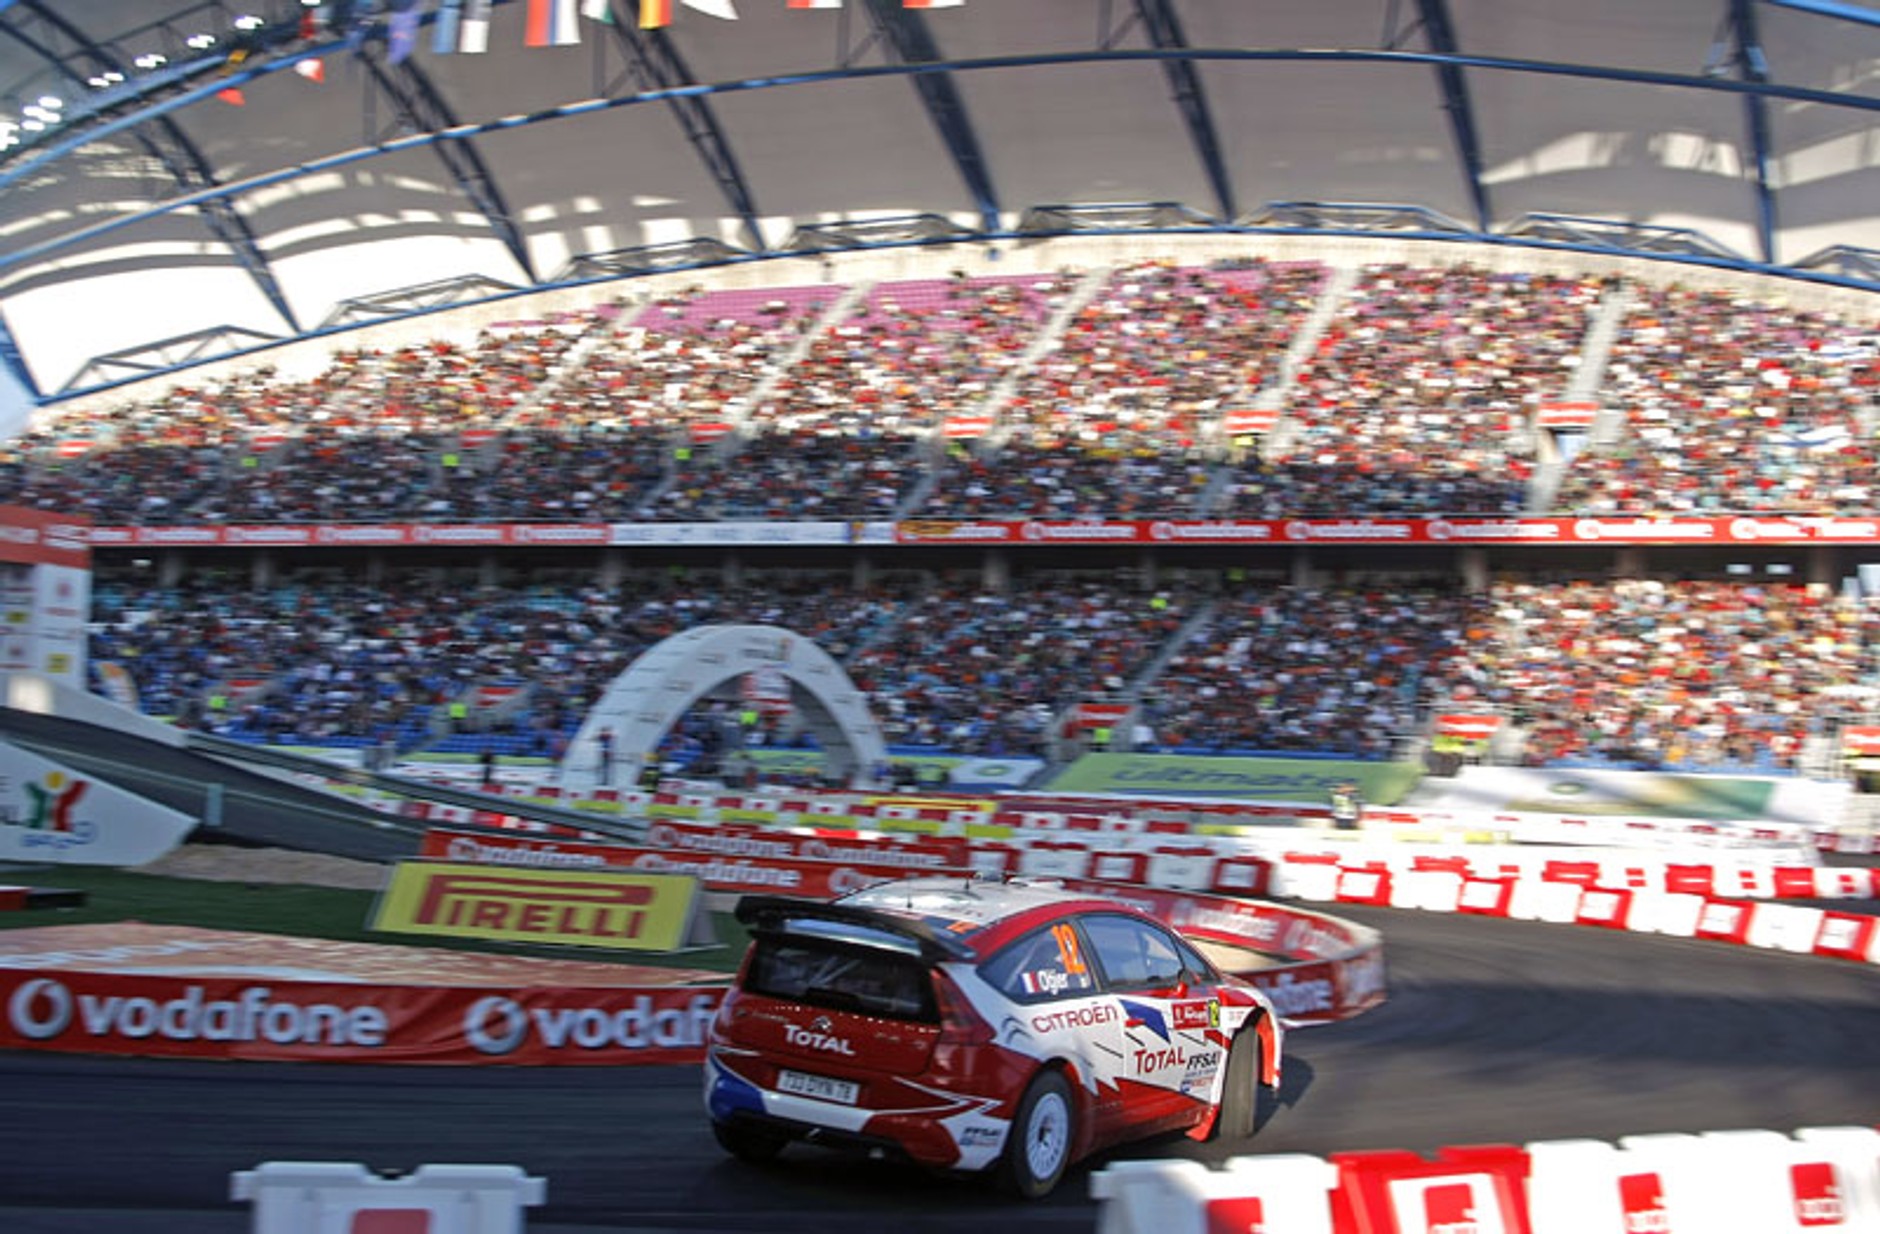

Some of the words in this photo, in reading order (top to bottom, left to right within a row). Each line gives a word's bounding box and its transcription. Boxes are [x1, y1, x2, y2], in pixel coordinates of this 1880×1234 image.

[414, 873, 655, 938] PIRELLI
[1051, 923, 1087, 974] 12
[77, 985, 388, 1046] vodafone
[783, 1023, 855, 1056] TOTAL
[1134, 1046, 1186, 1075] TOTAL
